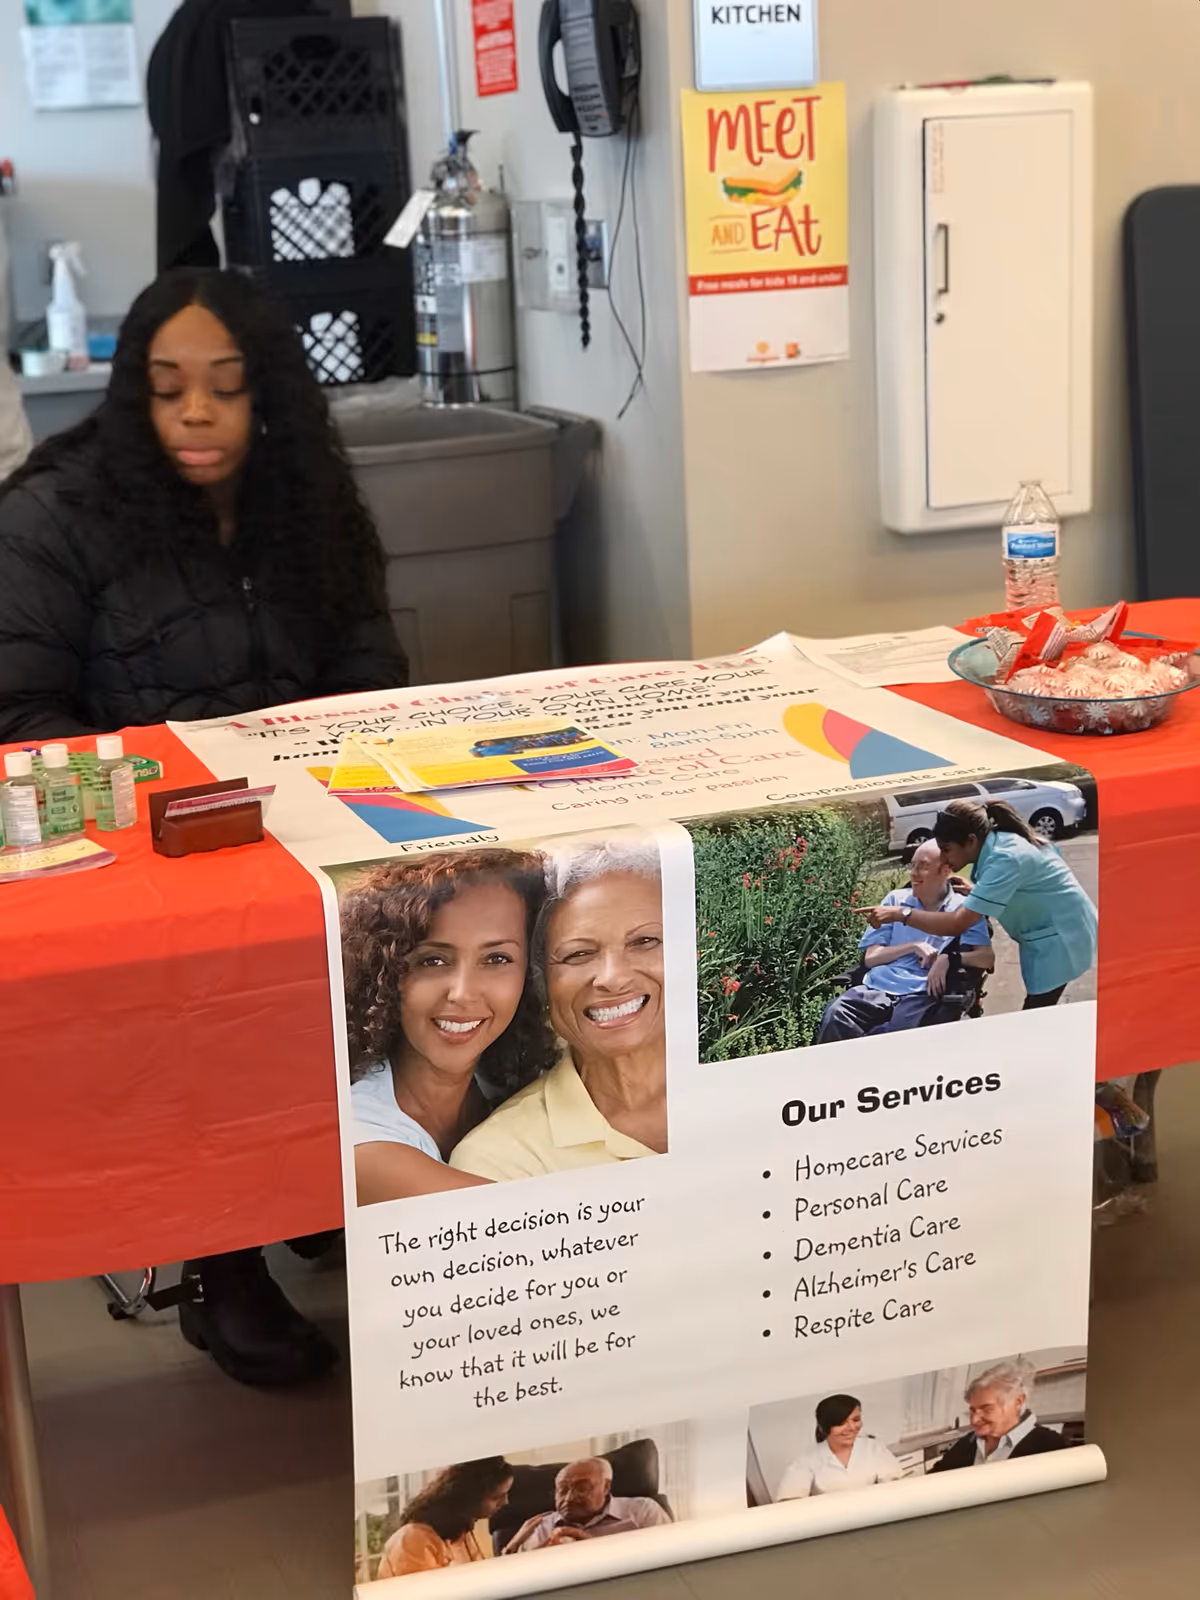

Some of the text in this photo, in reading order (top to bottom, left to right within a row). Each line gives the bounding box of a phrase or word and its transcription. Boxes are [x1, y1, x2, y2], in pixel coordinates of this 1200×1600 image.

[711, 4, 801, 24] KITCHEN
[712, 224, 745, 245] AND
[260, 703, 400, 727] Blessed
[320, 715, 400, 731] YOUR
[531, 689, 607, 703] YOUR
[456, 707, 535, 723] YOUR
[542, 696, 616, 711] OWN
[640, 705, 688, 716] you
[697, 695, 751, 707] and
[757, 688, 820, 701] your
[576, 768, 742, 794] Home Care
[677, 760, 710, 772] of
[720, 750, 807, 765] Care
[551, 775, 788, 811] Caring is our passion
[766, 766, 992, 801] Compassionate care
[400, 835, 499, 852] Friendly
[781, 1072, 1002, 1127] Our Services
[795, 1128, 1003, 1182] Homecare Services
[794, 1177, 949, 1222] Personal Care
[378, 1197, 646, 1255] The right decision is your
[794, 1215, 962, 1263] Dementia Care
[390, 1232, 639, 1287] own decision, whatever
[794, 1250, 977, 1302] Alzheimer's Care
[402, 1269, 628, 1328] you decide for you or
[794, 1298, 935, 1338] Respite Care
[411, 1304, 621, 1360] your loved ones, we
[400, 1332, 636, 1390] know that it will be for
[473, 1376, 563, 1408] the best.
